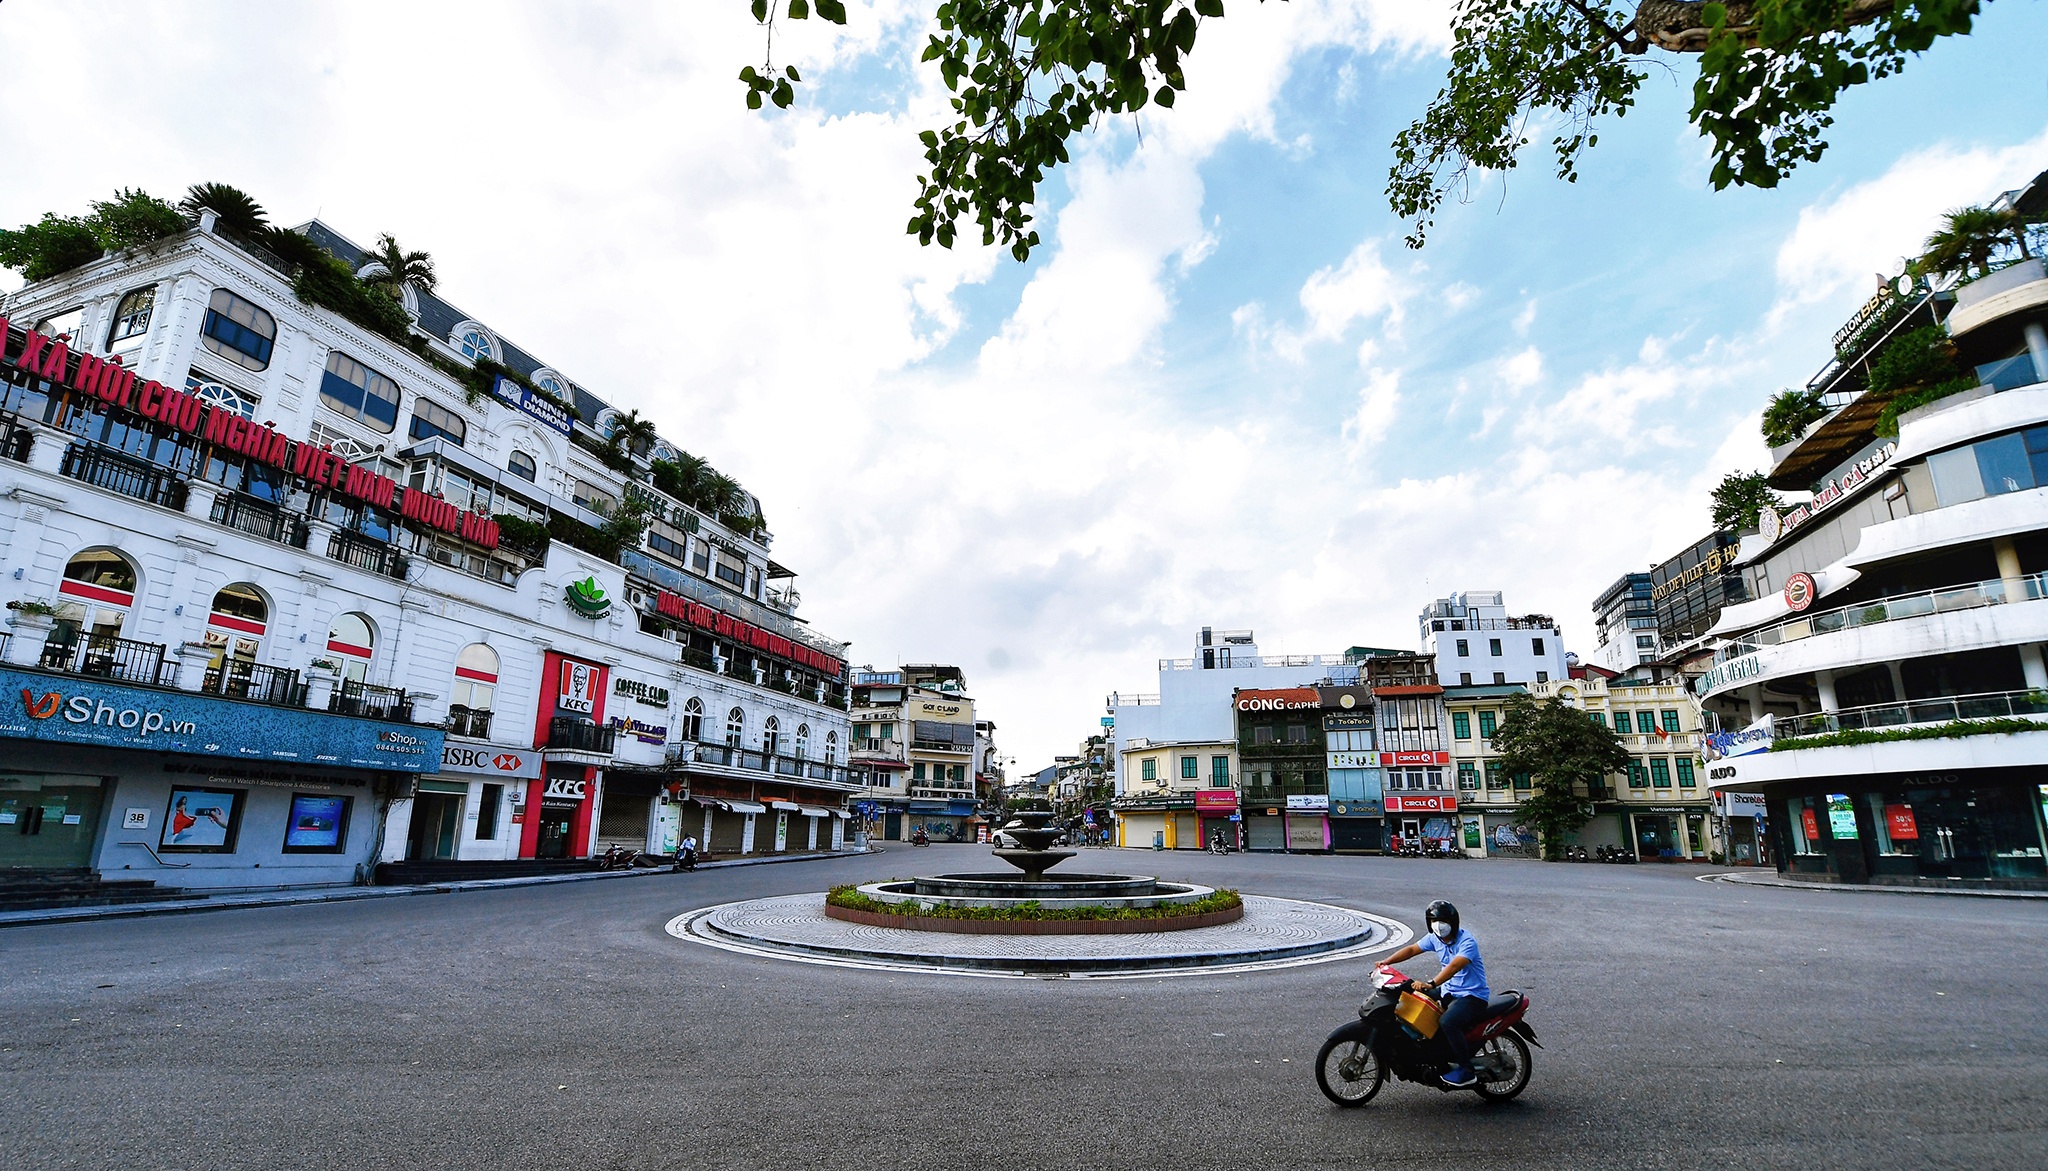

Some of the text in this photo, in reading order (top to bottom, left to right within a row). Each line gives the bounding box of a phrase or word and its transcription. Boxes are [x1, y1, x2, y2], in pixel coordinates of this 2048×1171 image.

[1832, 312, 1863, 347] AVALON
[523, 400, 571, 432] DIAMOND
[531, 393, 568, 421] MINH
[17, 328, 72, 384] XÃ
[74, 353, 136, 411] HỘI
[138, 379, 202, 433] CHỦ
[205, 405, 288, 468] NGHĨA
[294, 442, 347, 491] VIỆT
[344, 463, 396, 509] NAM
[402, 487, 459, 534] MUÔN
[461, 508, 500, 550] NĂM
[623, 481, 700, 534] COFFEE CLUB
[1652, 584, 1668, 601] MAY
[1668, 577, 1681, 592] DE
[1680, 563, 1704, 588] VILLE
[1785, 574, 1810, 596] HIGHLANDS
[1791, 595, 1811, 610] COFFEE
[616, 678, 647, 697] COFFEE
[564, 698, 589, 711] KFC
[1238, 696, 1285, 714] CỘNG
[272, 750, 298, 758] SAMSUNG
[441, 746, 489, 768] HSBC
[1710, 766, 1736, 780] ALDO
[1902, 774, 1959, 785] ALDO
[260, 780, 293, 788] Smartphone
[544, 778, 586, 797] KFC
[130, 813, 145, 821] 3B
